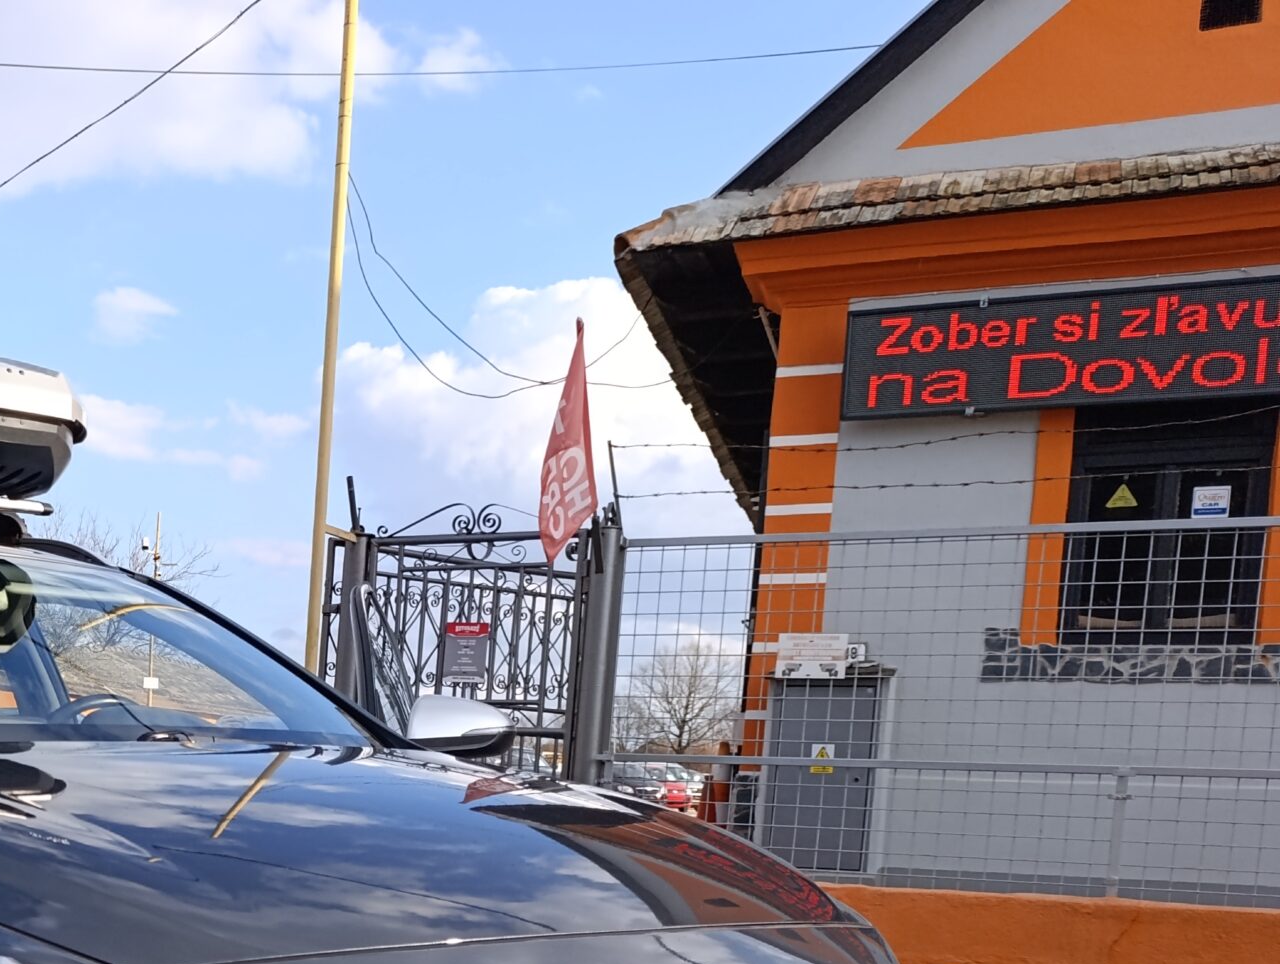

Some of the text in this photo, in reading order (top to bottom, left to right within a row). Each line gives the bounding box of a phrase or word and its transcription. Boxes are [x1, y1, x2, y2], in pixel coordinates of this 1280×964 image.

[876, 295, 1280, 356] Zober si zľavu
[867, 338, 1280, 408] na Dovol
